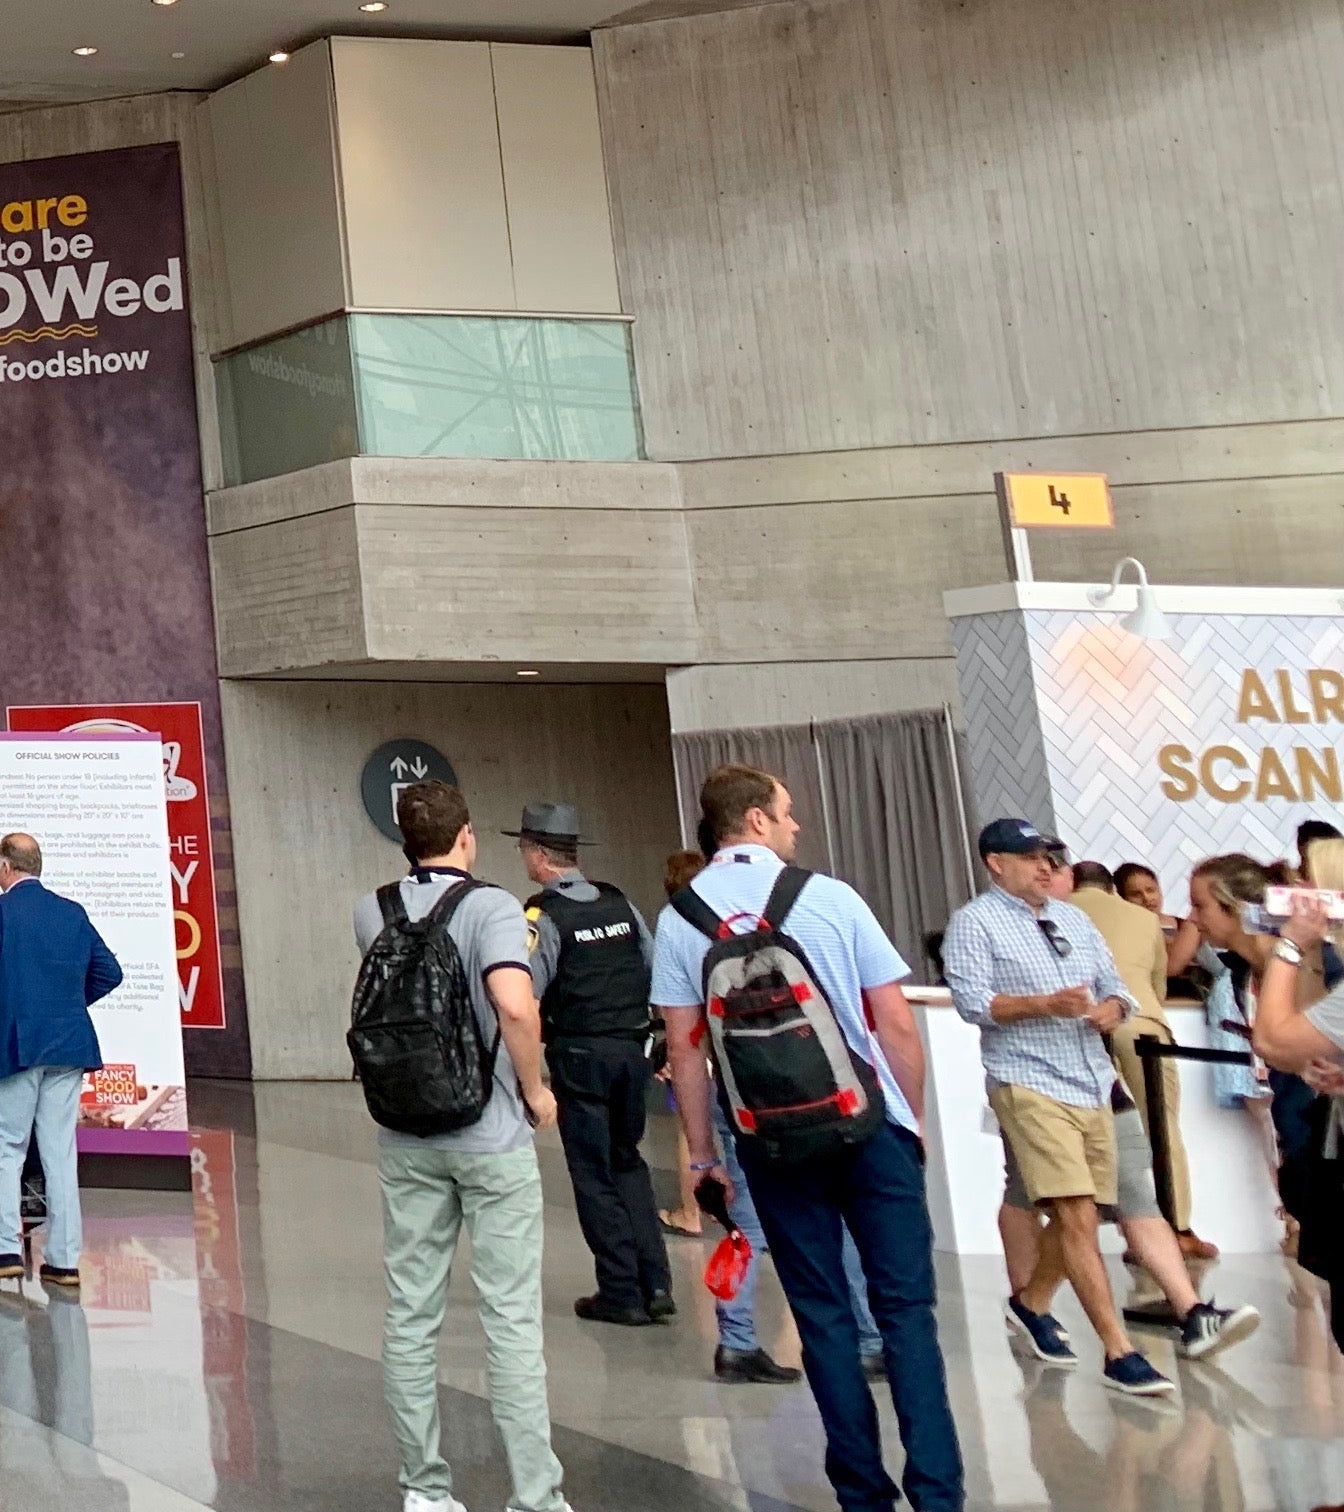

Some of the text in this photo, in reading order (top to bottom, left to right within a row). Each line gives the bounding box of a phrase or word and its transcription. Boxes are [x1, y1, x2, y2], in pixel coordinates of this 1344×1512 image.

[42, 228, 94, 263] be
[1048, 484, 1071, 515] 4
[1236, 668, 1344, 724] ALR
[15, 752, 120, 760] OFFICIAL SHOW POLICIES
[1157, 743, 1344, 804] SCAN
[574, 922, 631, 942] PUBLIC SAFETY
[94, 1070, 135, 1081] FANCY
[95, 1081, 135, 1093] FOOD
[96, 1093, 135, 1104] SHOW
